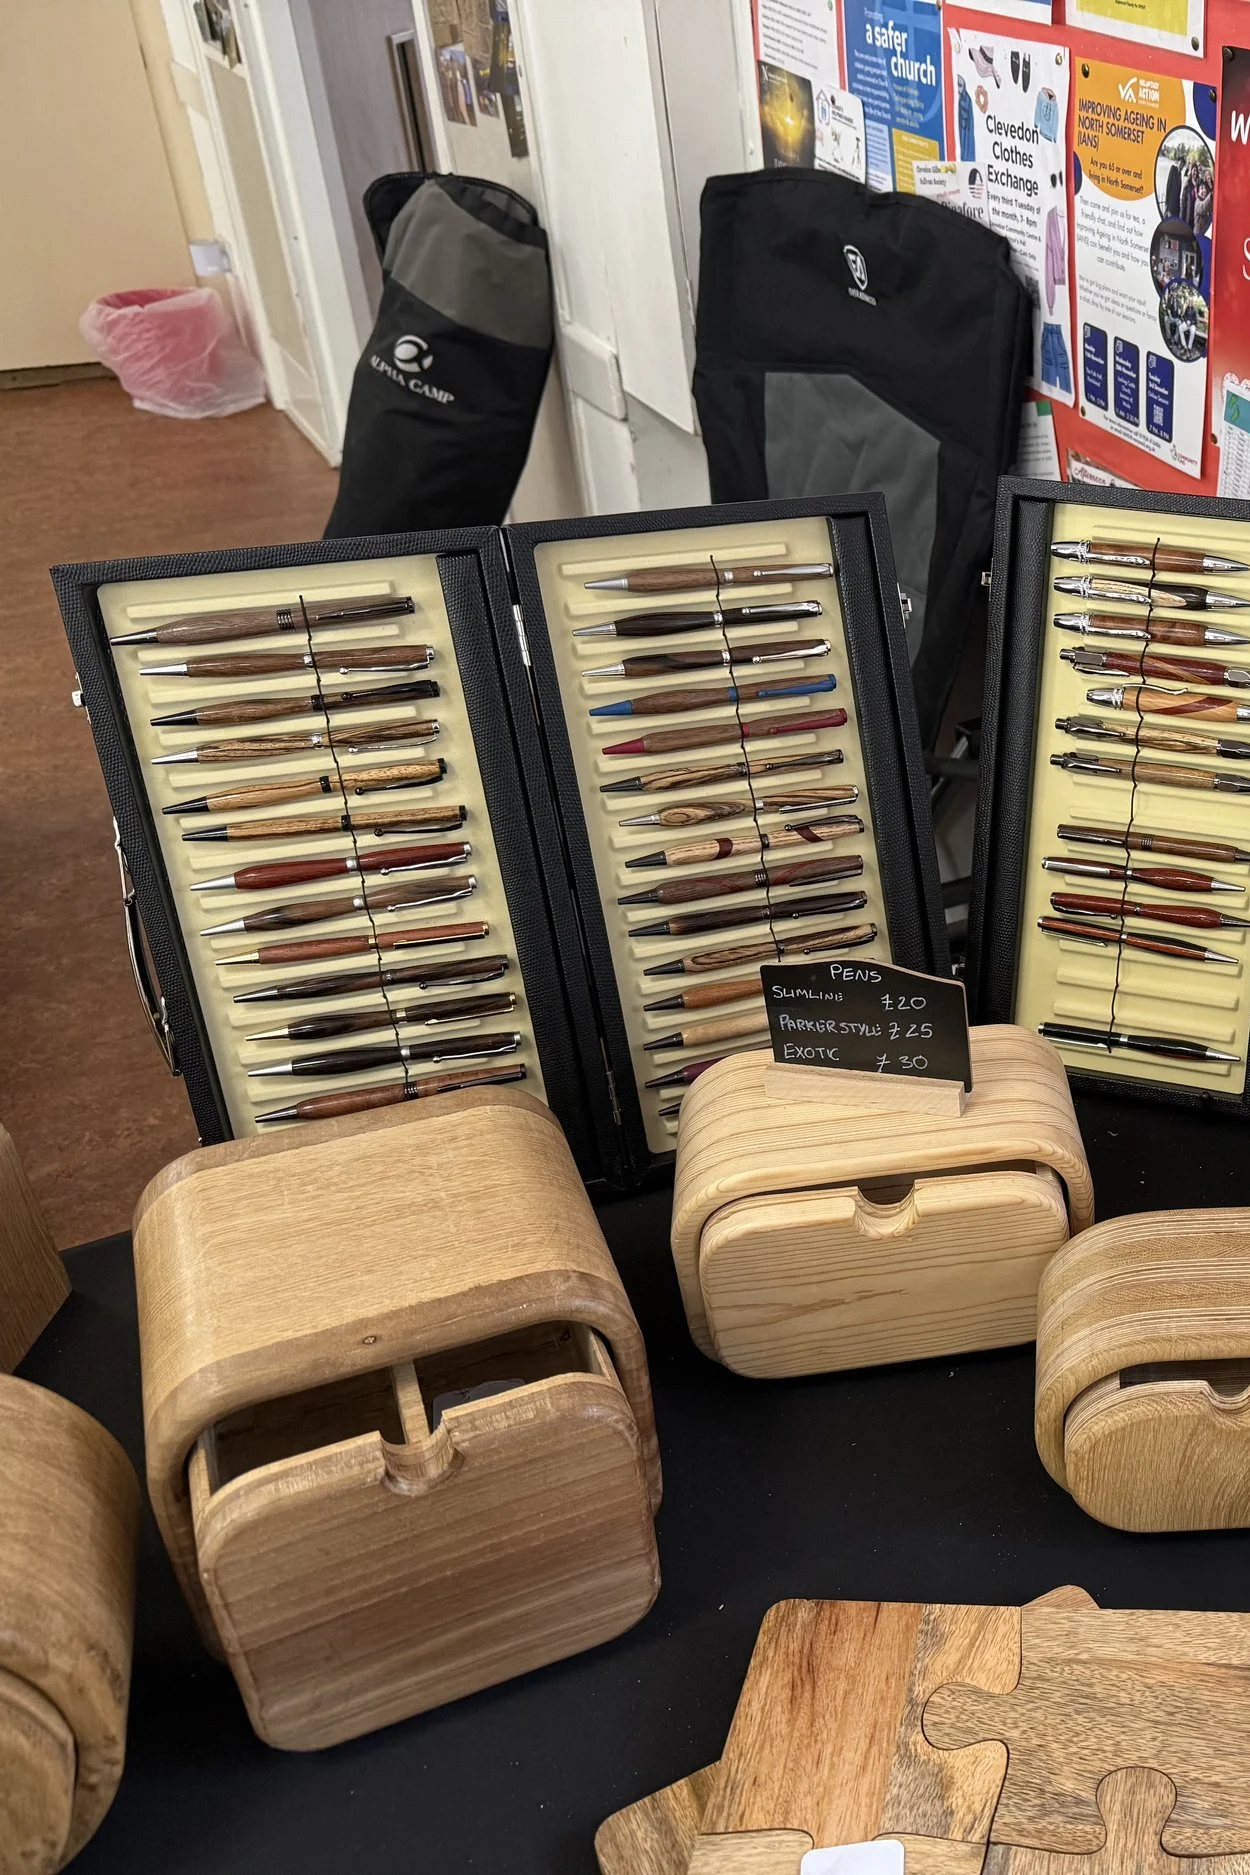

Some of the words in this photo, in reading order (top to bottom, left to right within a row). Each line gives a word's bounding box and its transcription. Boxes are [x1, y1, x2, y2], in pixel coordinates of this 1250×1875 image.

[866, 24, 873, 44] a
[875, 19, 907, 52] safer
[891, 54, 936, 86] church
[986, 114, 1039, 144] Clevedon
[1078, 115, 1103, 133] NORTH
[1106, 123, 1145, 145] SOMERSET
[1079, 99, 1121, 122] IMPROVING
[1123, 110, 1154, 129] AGEING
[1157, 117, 1167, 133] IN
[992, 141, 1033, 169] Clothes
[1078, 131, 1099, 150] (IANS)
[987, 165, 1039, 197] Exchange
[1099, 160, 1107, 170] you
[1109, 162, 1115, 171] 65
[1122, 167, 1131, 176] over
[1133, 169, 1142, 179] and
[1107, 176, 1119, 188] North
[370, 354, 406, 386] ALPHA
[408, 379, 455, 404] CAMP
[830, 964, 882, 983] PENS
[772, 986, 843, 1002] SLIMLINE
[881, 994, 926, 1011] £20
[784, 1043, 840, 1061] EXOTIC
